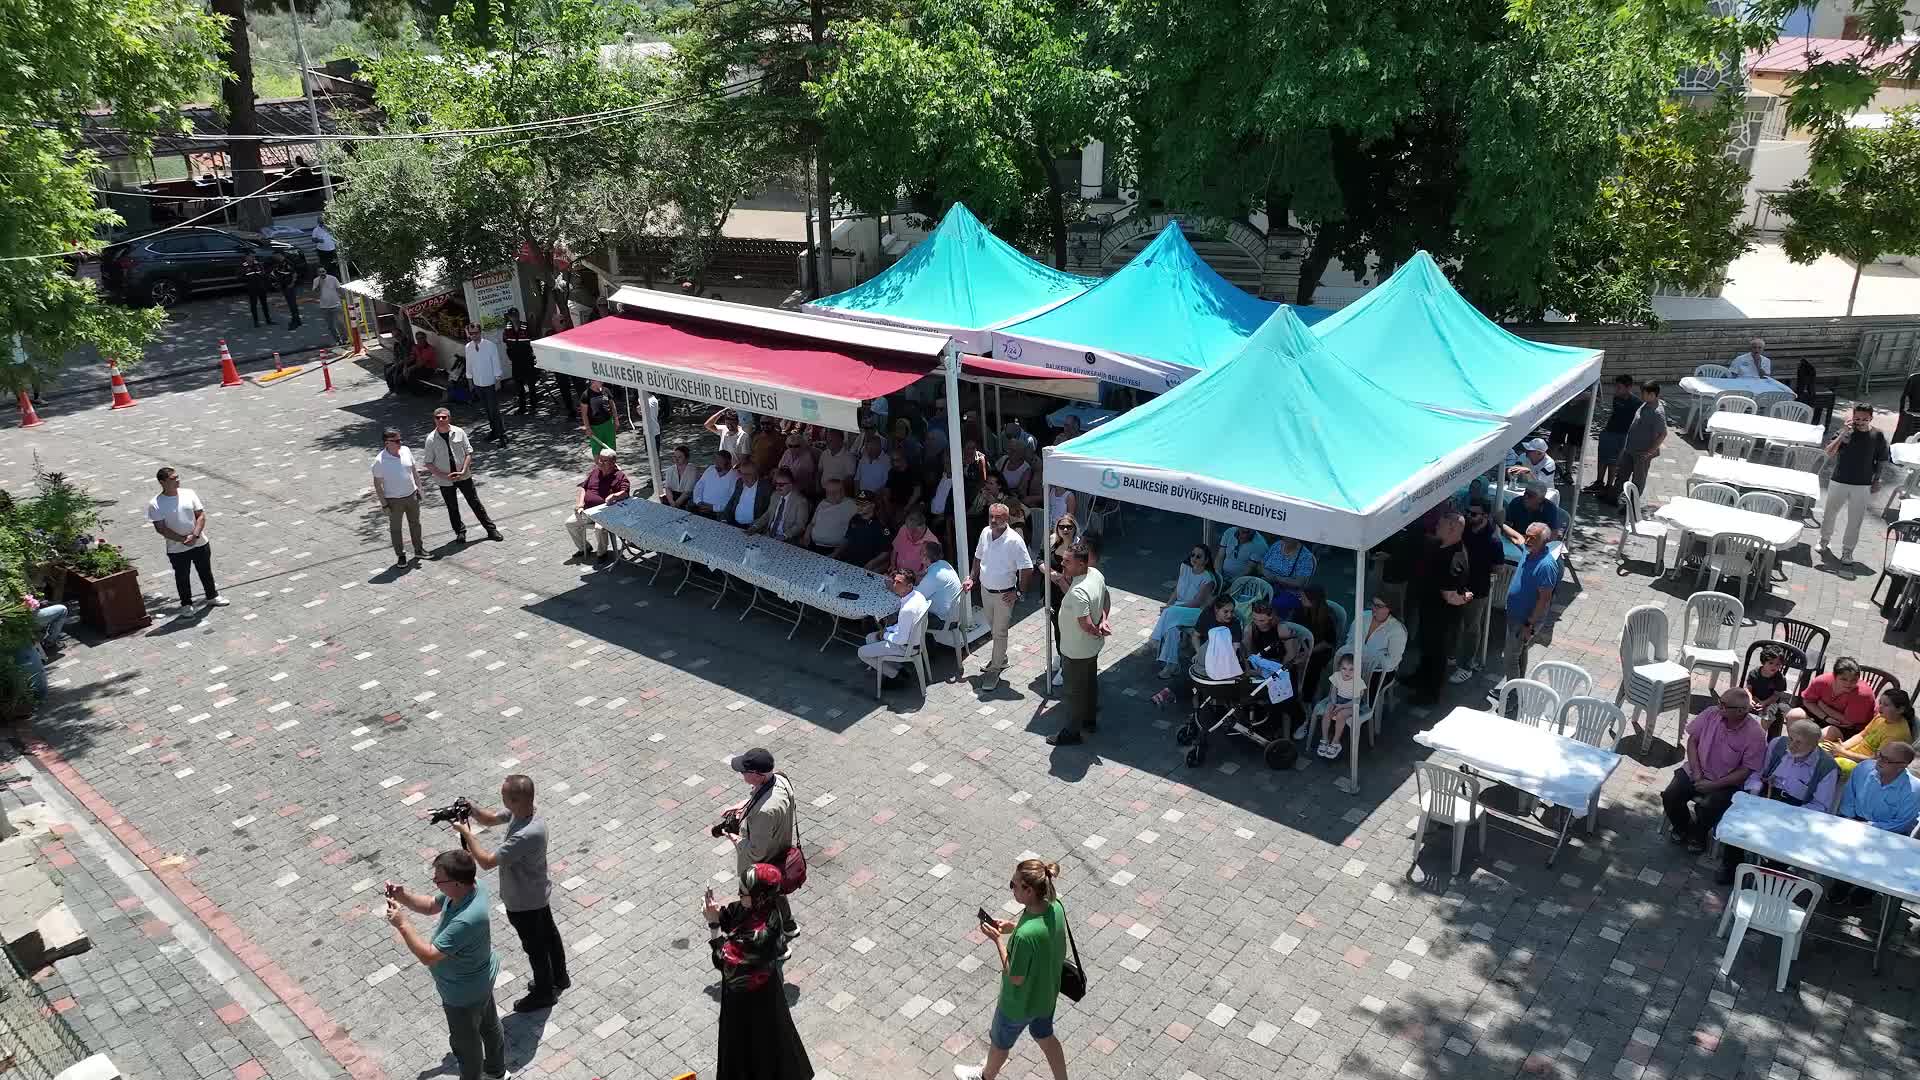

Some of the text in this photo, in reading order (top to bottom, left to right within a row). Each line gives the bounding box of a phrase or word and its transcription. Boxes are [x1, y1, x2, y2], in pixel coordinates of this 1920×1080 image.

[592, 360, 644, 385] BALIKESİR
[714, 386, 778, 410] BELEDİYESİ
[1123, 476, 1288, 522] BALIKESİR BÜYÜKŞEHİR BELEDİYESİ
